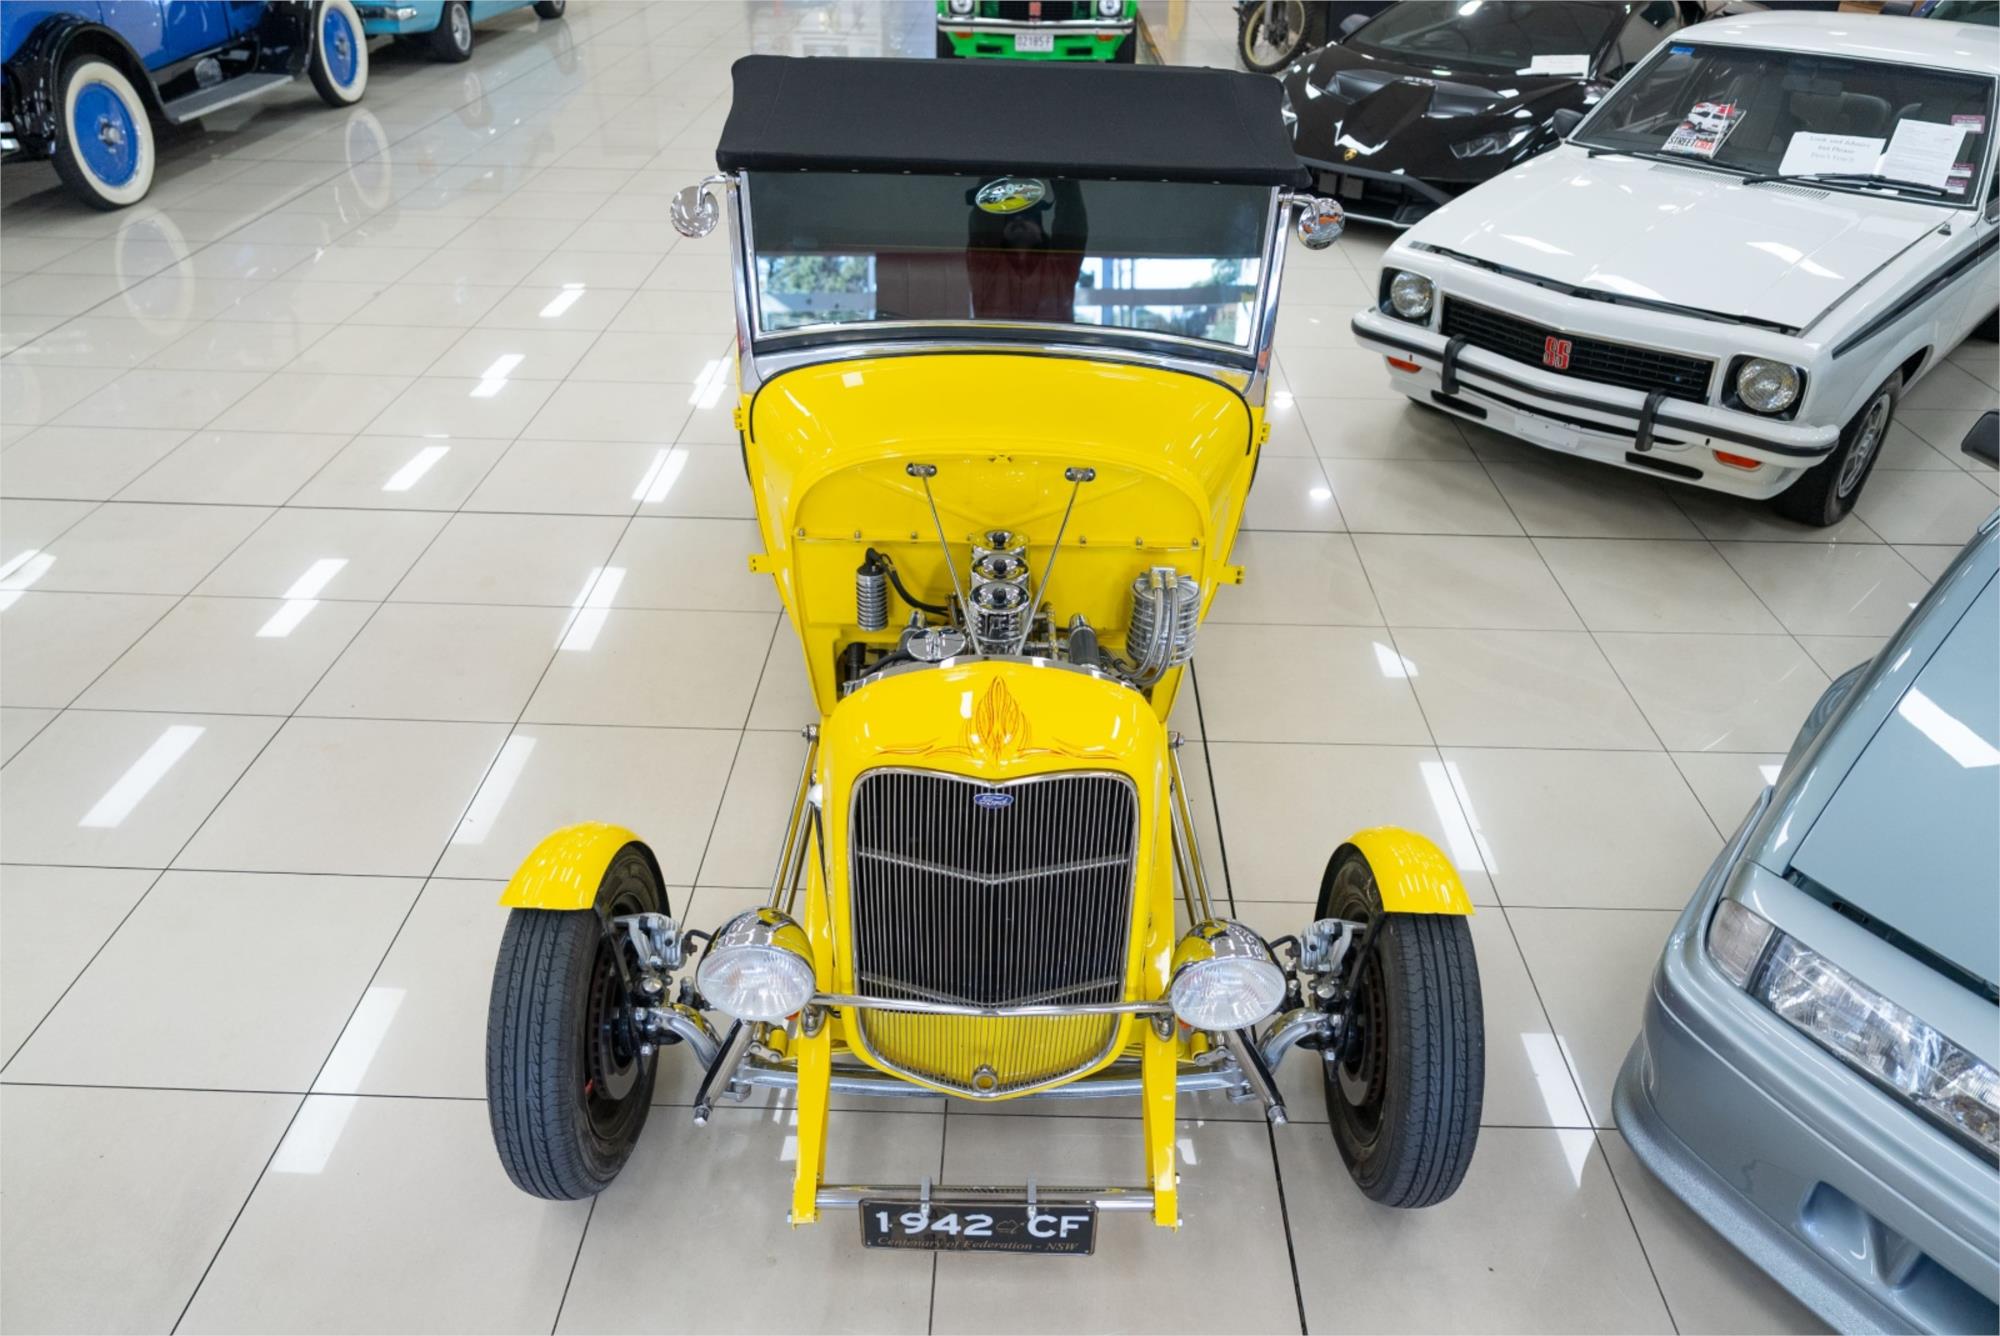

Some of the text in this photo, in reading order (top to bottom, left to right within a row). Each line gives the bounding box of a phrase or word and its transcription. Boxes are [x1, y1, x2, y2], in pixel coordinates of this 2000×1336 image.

[978, 795, 1010, 807] Ford
[875, 1210, 1090, 1238] 1942 CF
[877, 1236, 944, 1249] Centenary
[946, 1239, 960, 1249] of
[962, 1240, 1033, 1251] Federation
[1044, 1242, 1079, 1251] NSW
